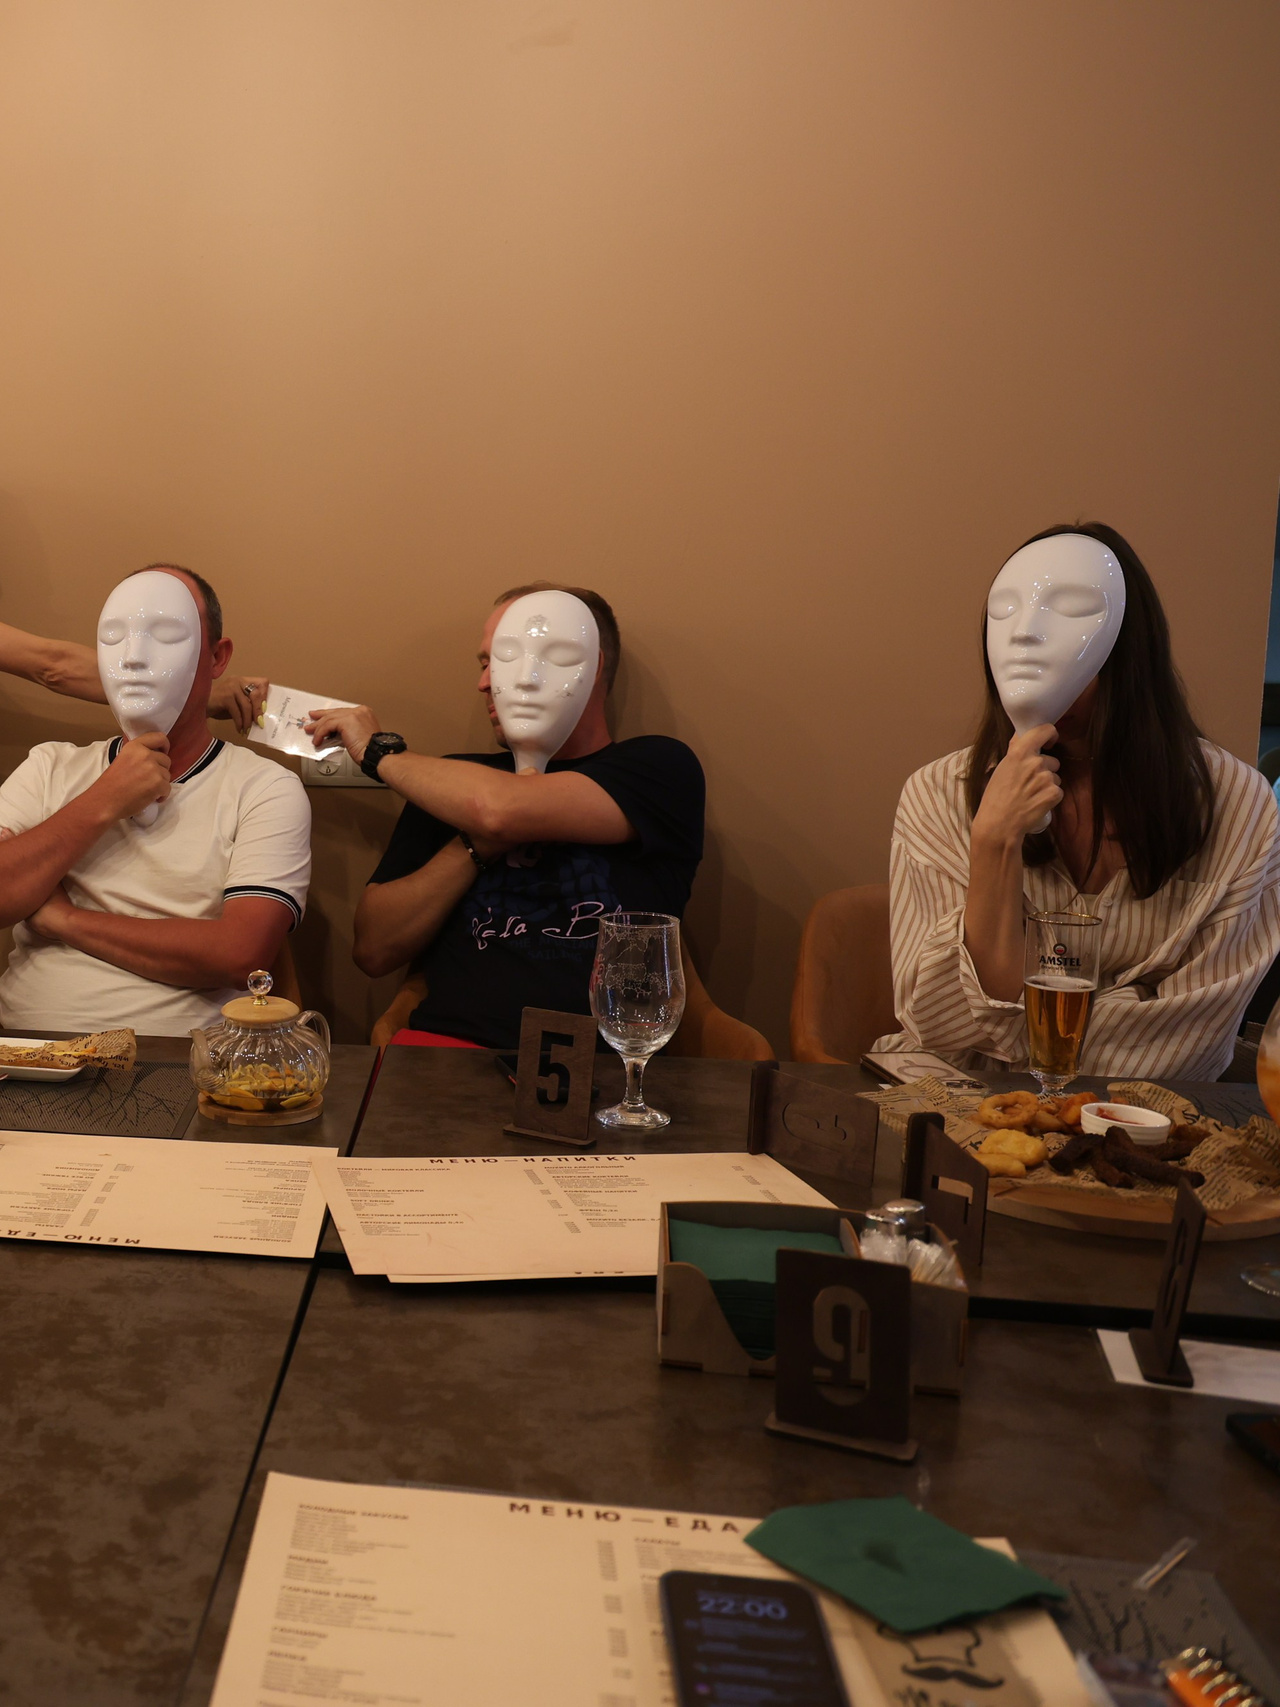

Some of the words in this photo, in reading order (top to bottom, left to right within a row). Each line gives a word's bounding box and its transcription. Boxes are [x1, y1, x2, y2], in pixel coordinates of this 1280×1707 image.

[1039, 955, 1081, 967] AMSTEL
[536, 1030, 574, 1112] 5
[812, 1285, 871, 1406] 9
[697, 1596, 789, 1620] 22:00
